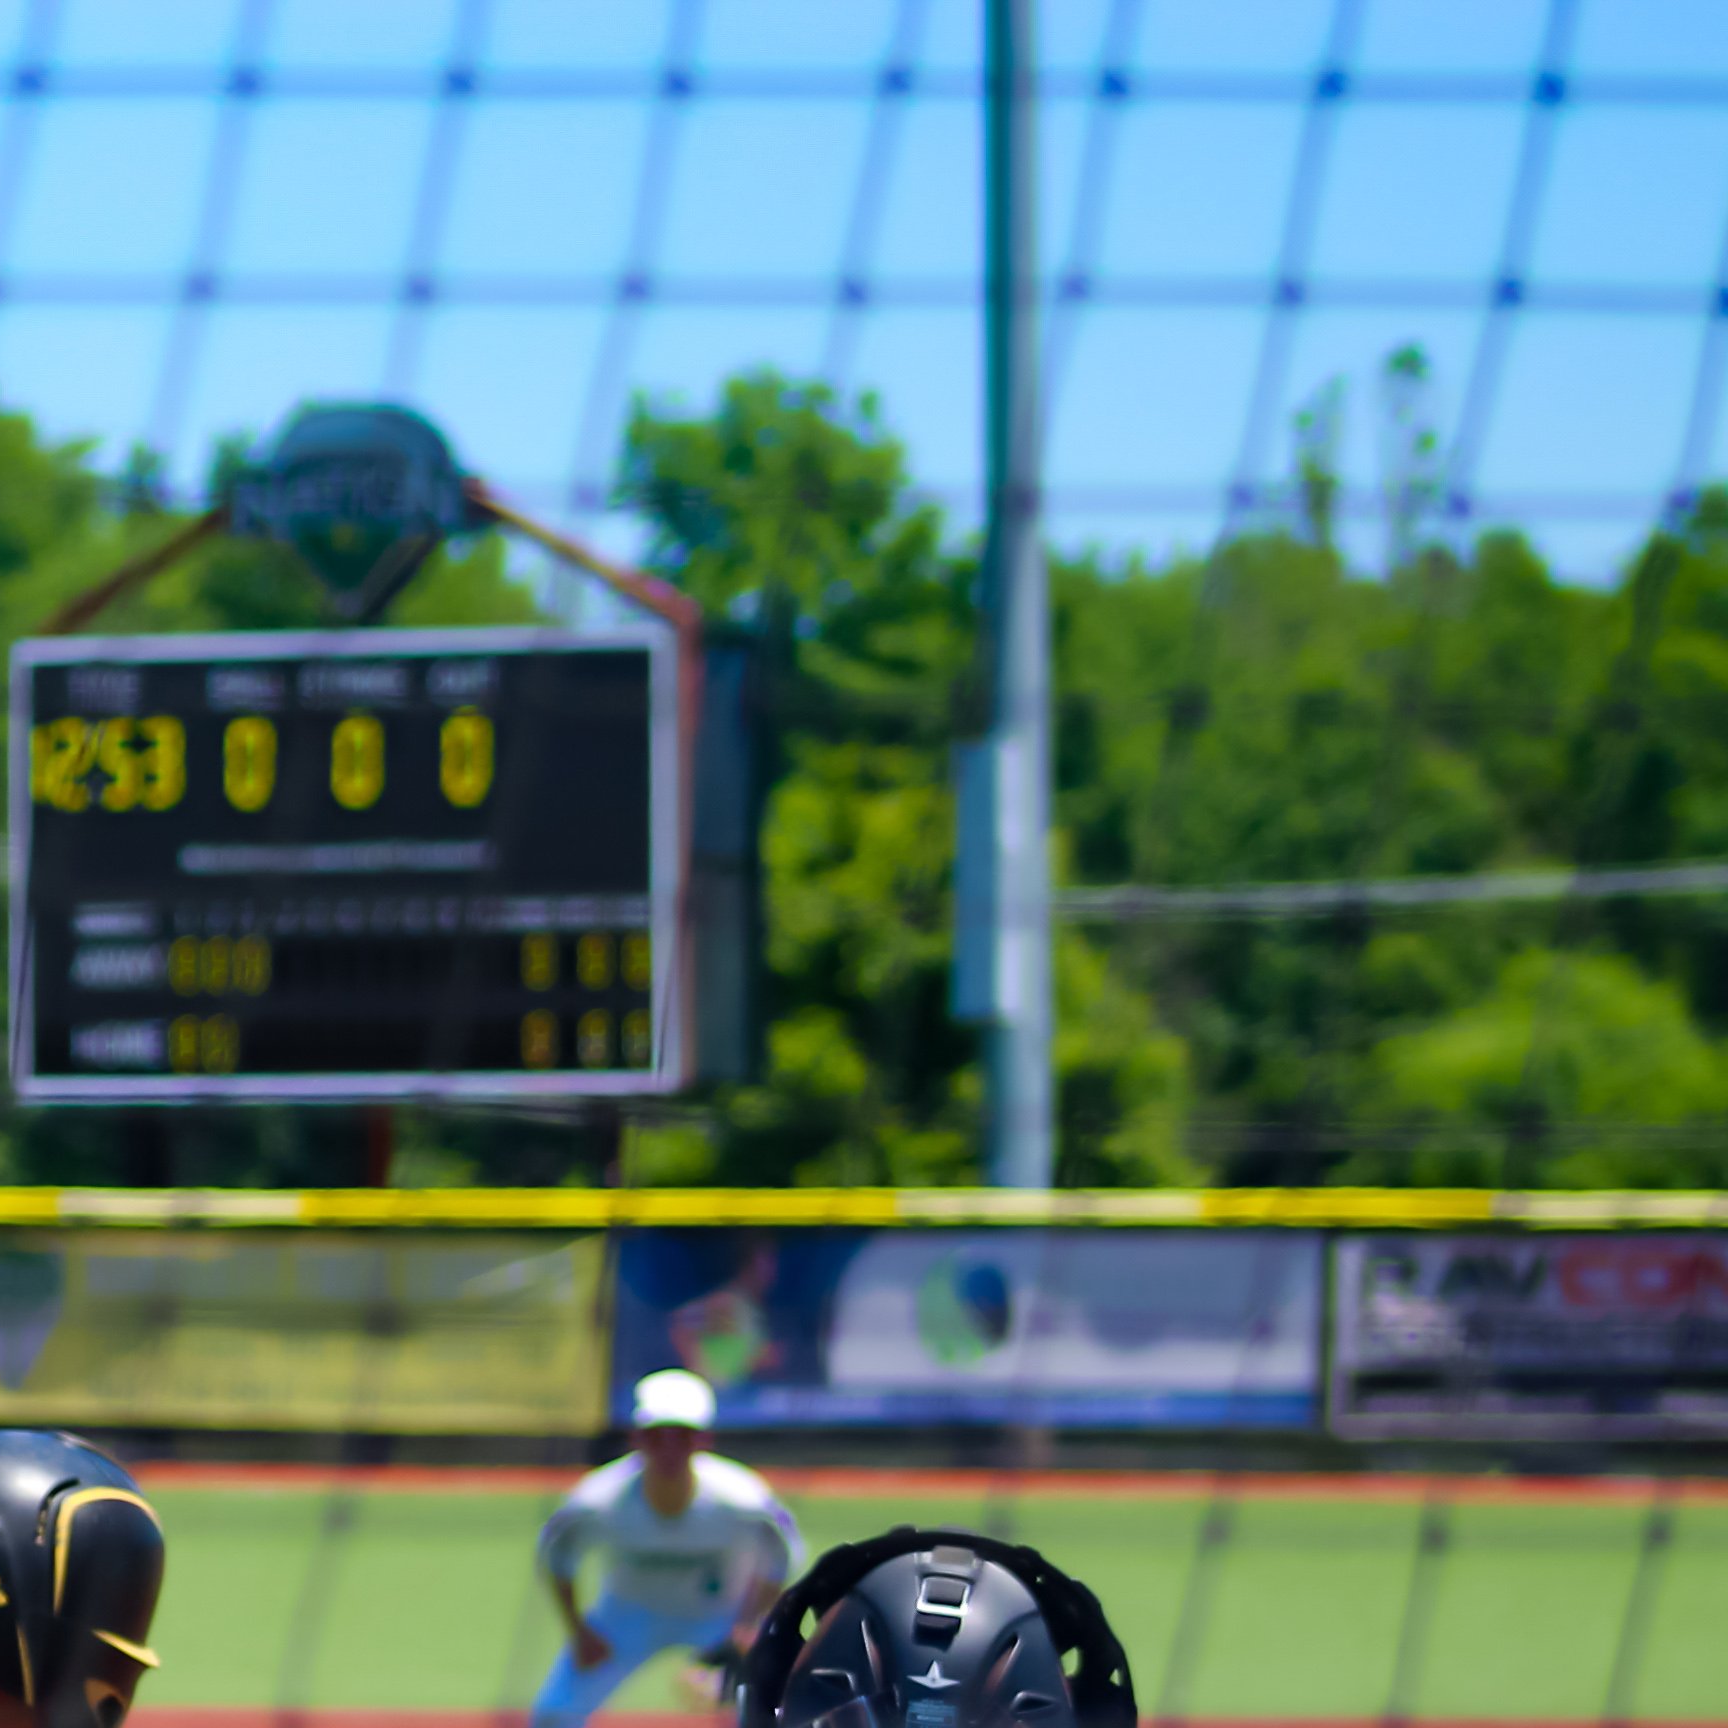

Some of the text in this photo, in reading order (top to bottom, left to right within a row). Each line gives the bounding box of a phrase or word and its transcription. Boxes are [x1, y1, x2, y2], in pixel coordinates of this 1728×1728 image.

[223, 716, 278, 812] 0
[330, 714, 385, 810] 0
[439, 712, 494, 809] 0
